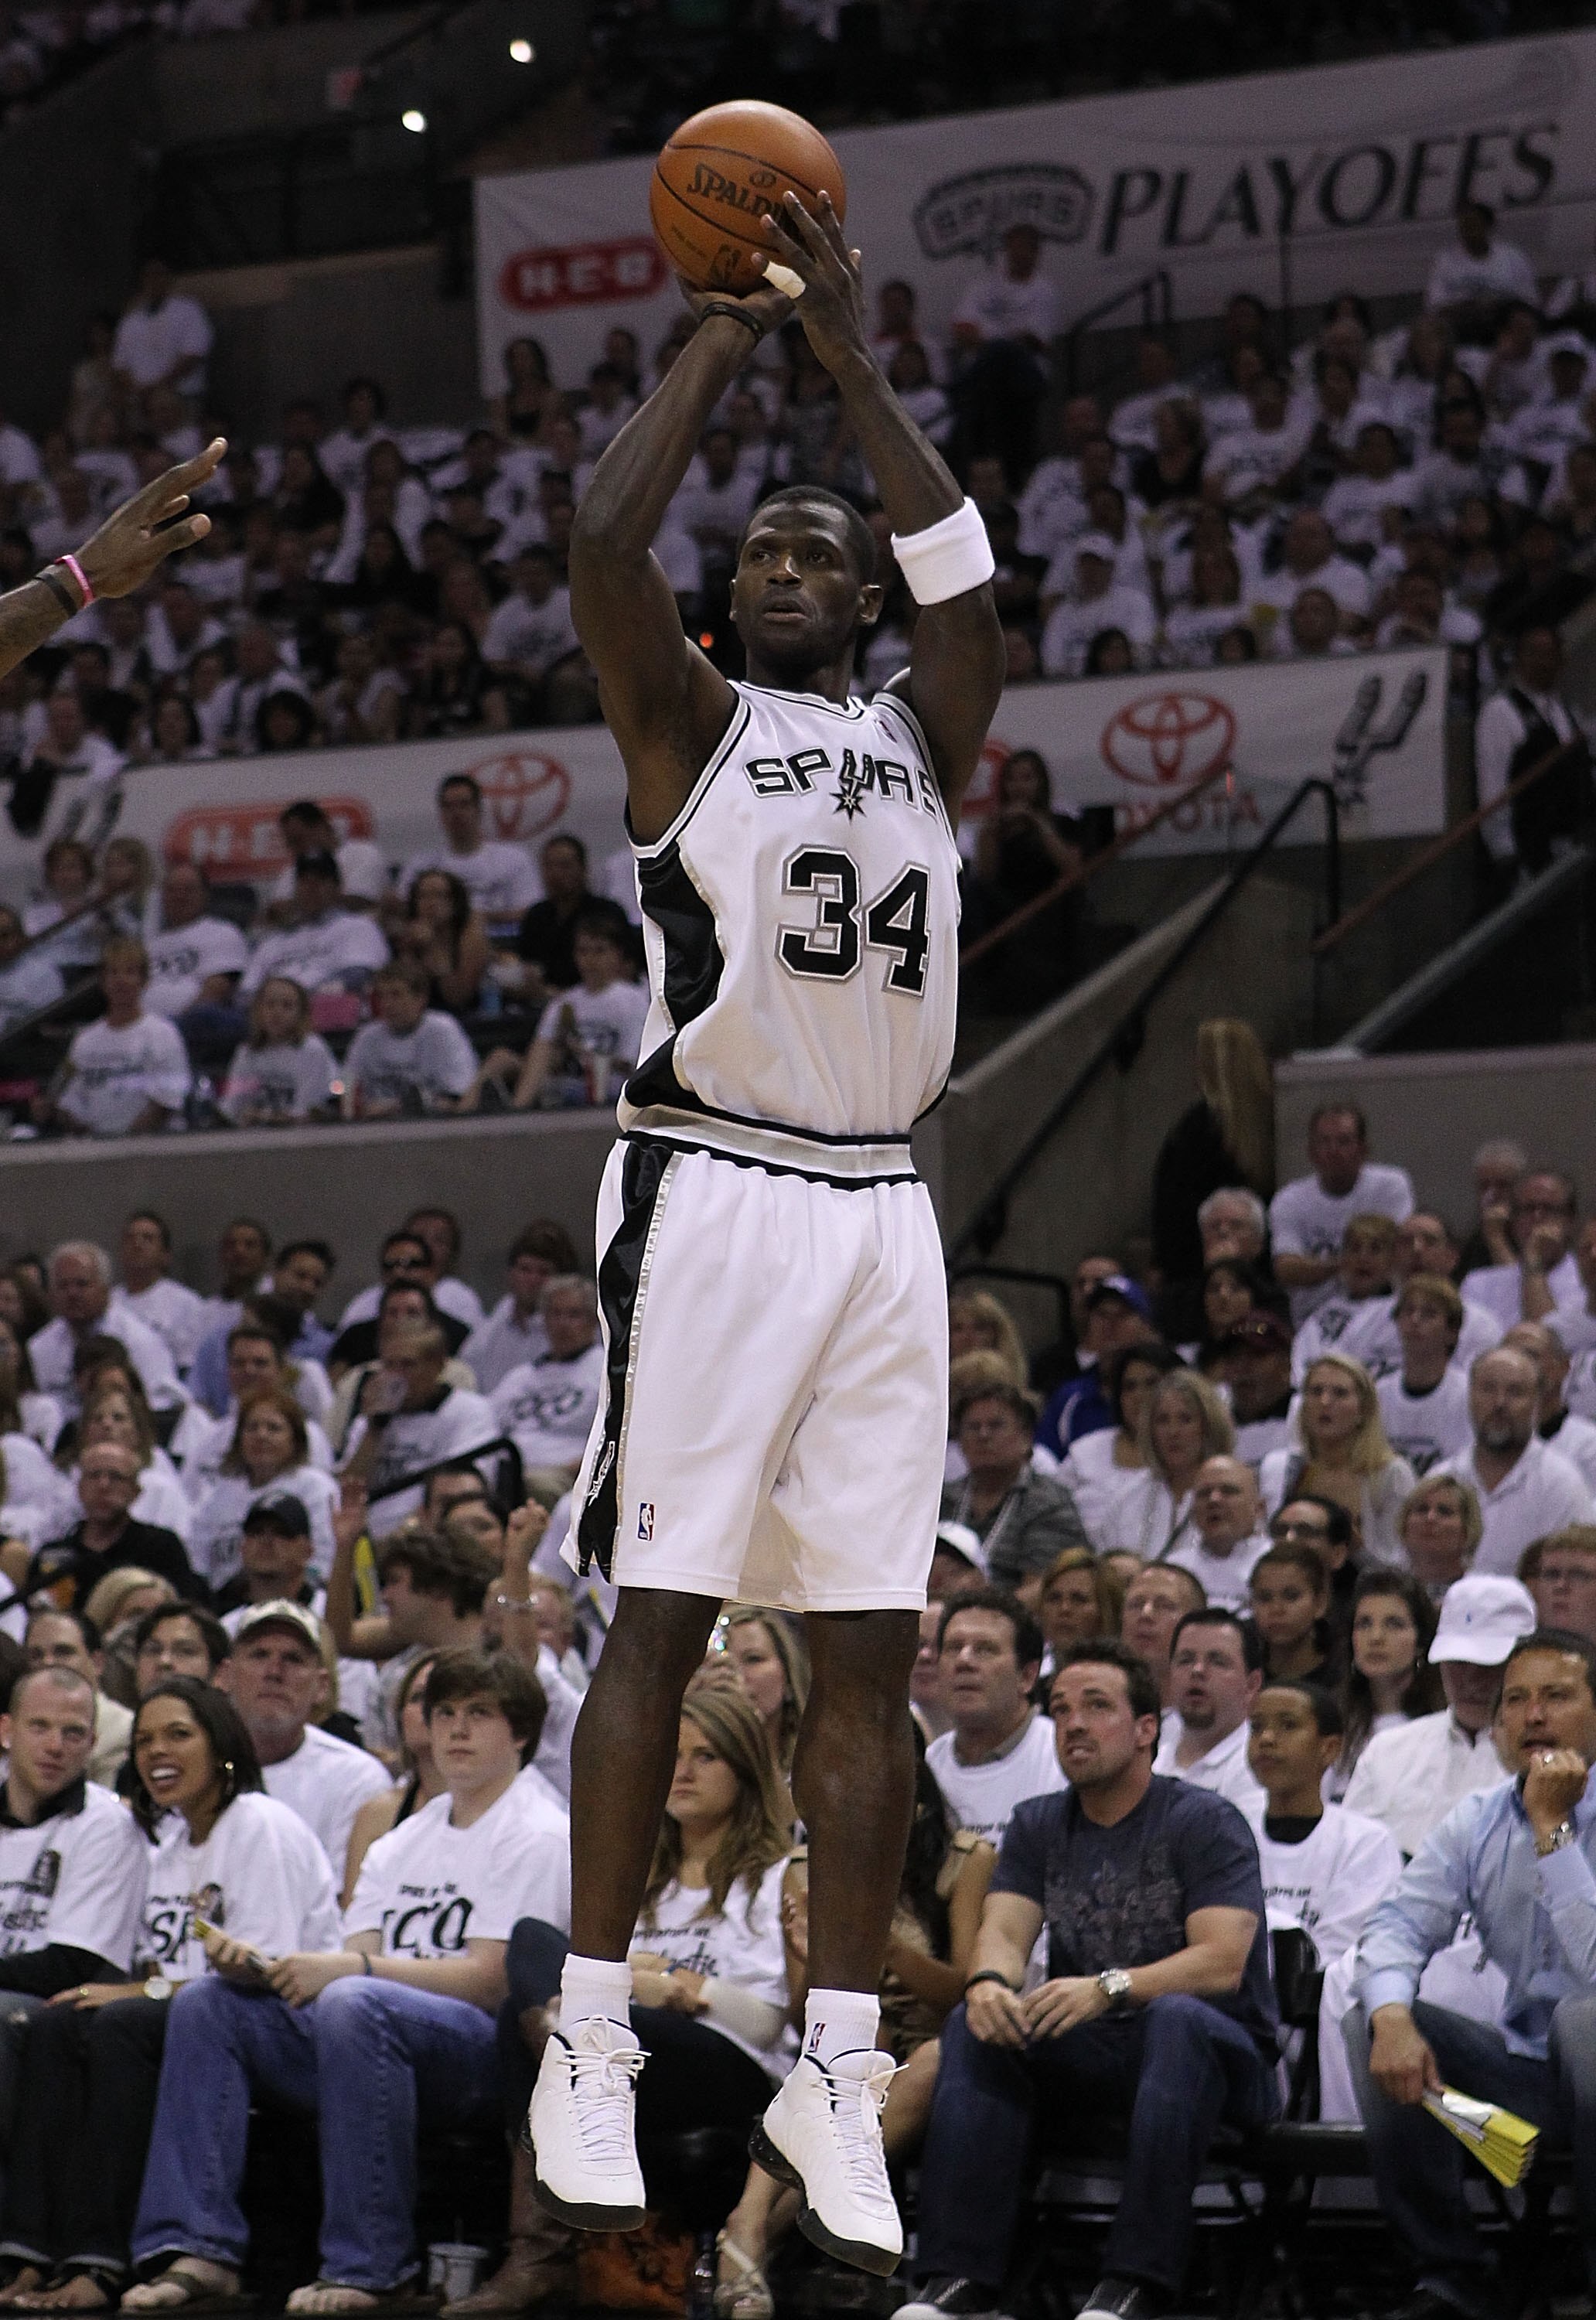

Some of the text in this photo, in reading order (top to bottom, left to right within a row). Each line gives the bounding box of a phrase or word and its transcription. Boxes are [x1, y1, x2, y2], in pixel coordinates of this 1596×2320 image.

[1099, 121, 1560, 254] PLAYOFFS
[743, 746, 938, 820] SPURS
[776, 844, 930, 997] 34
